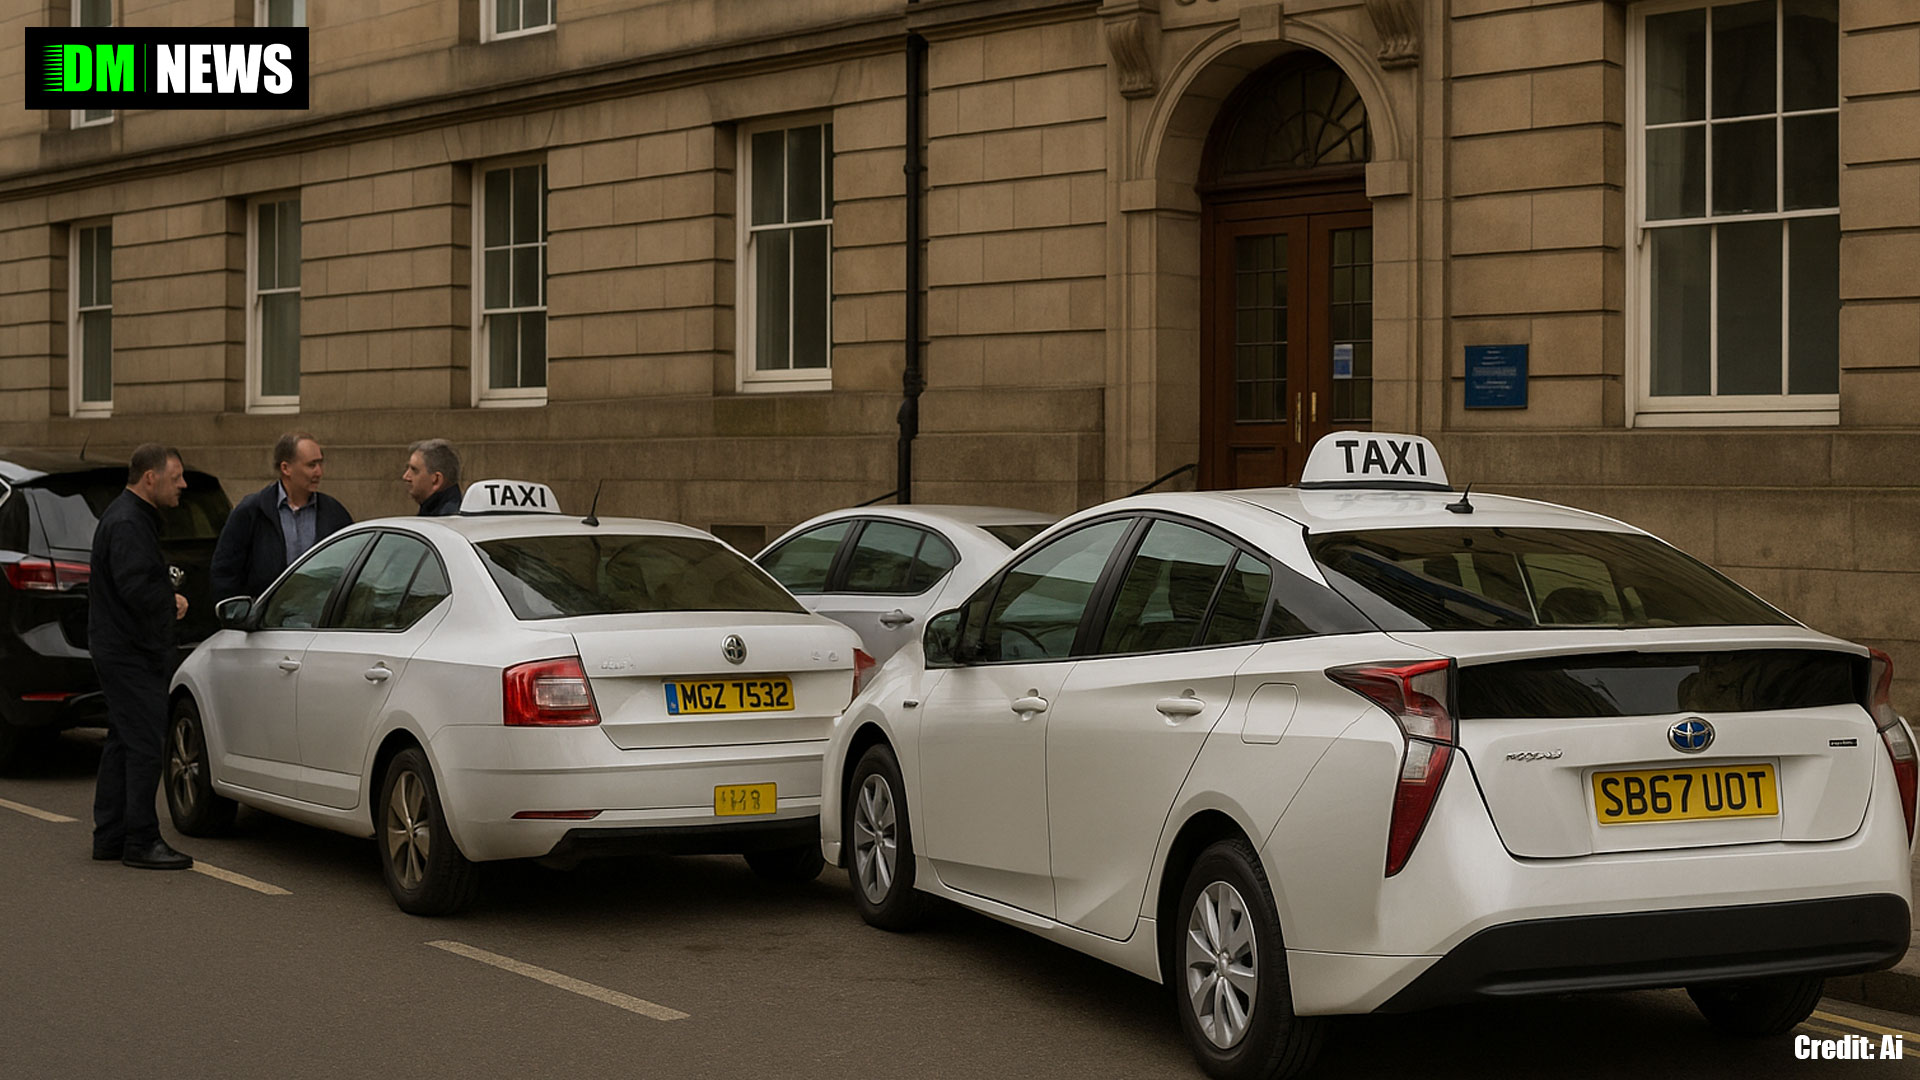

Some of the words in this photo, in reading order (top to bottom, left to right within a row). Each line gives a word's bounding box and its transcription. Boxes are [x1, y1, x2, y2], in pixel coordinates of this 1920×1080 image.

[1336, 440, 1427, 476] TAXI
[484, 485, 546, 507] TAXI
[680, 683, 726, 710] MGZ
[731, 682, 789, 707] 7532
[1601, 774, 1693, 817] SB67
[1703, 771, 1768, 812] UOT
